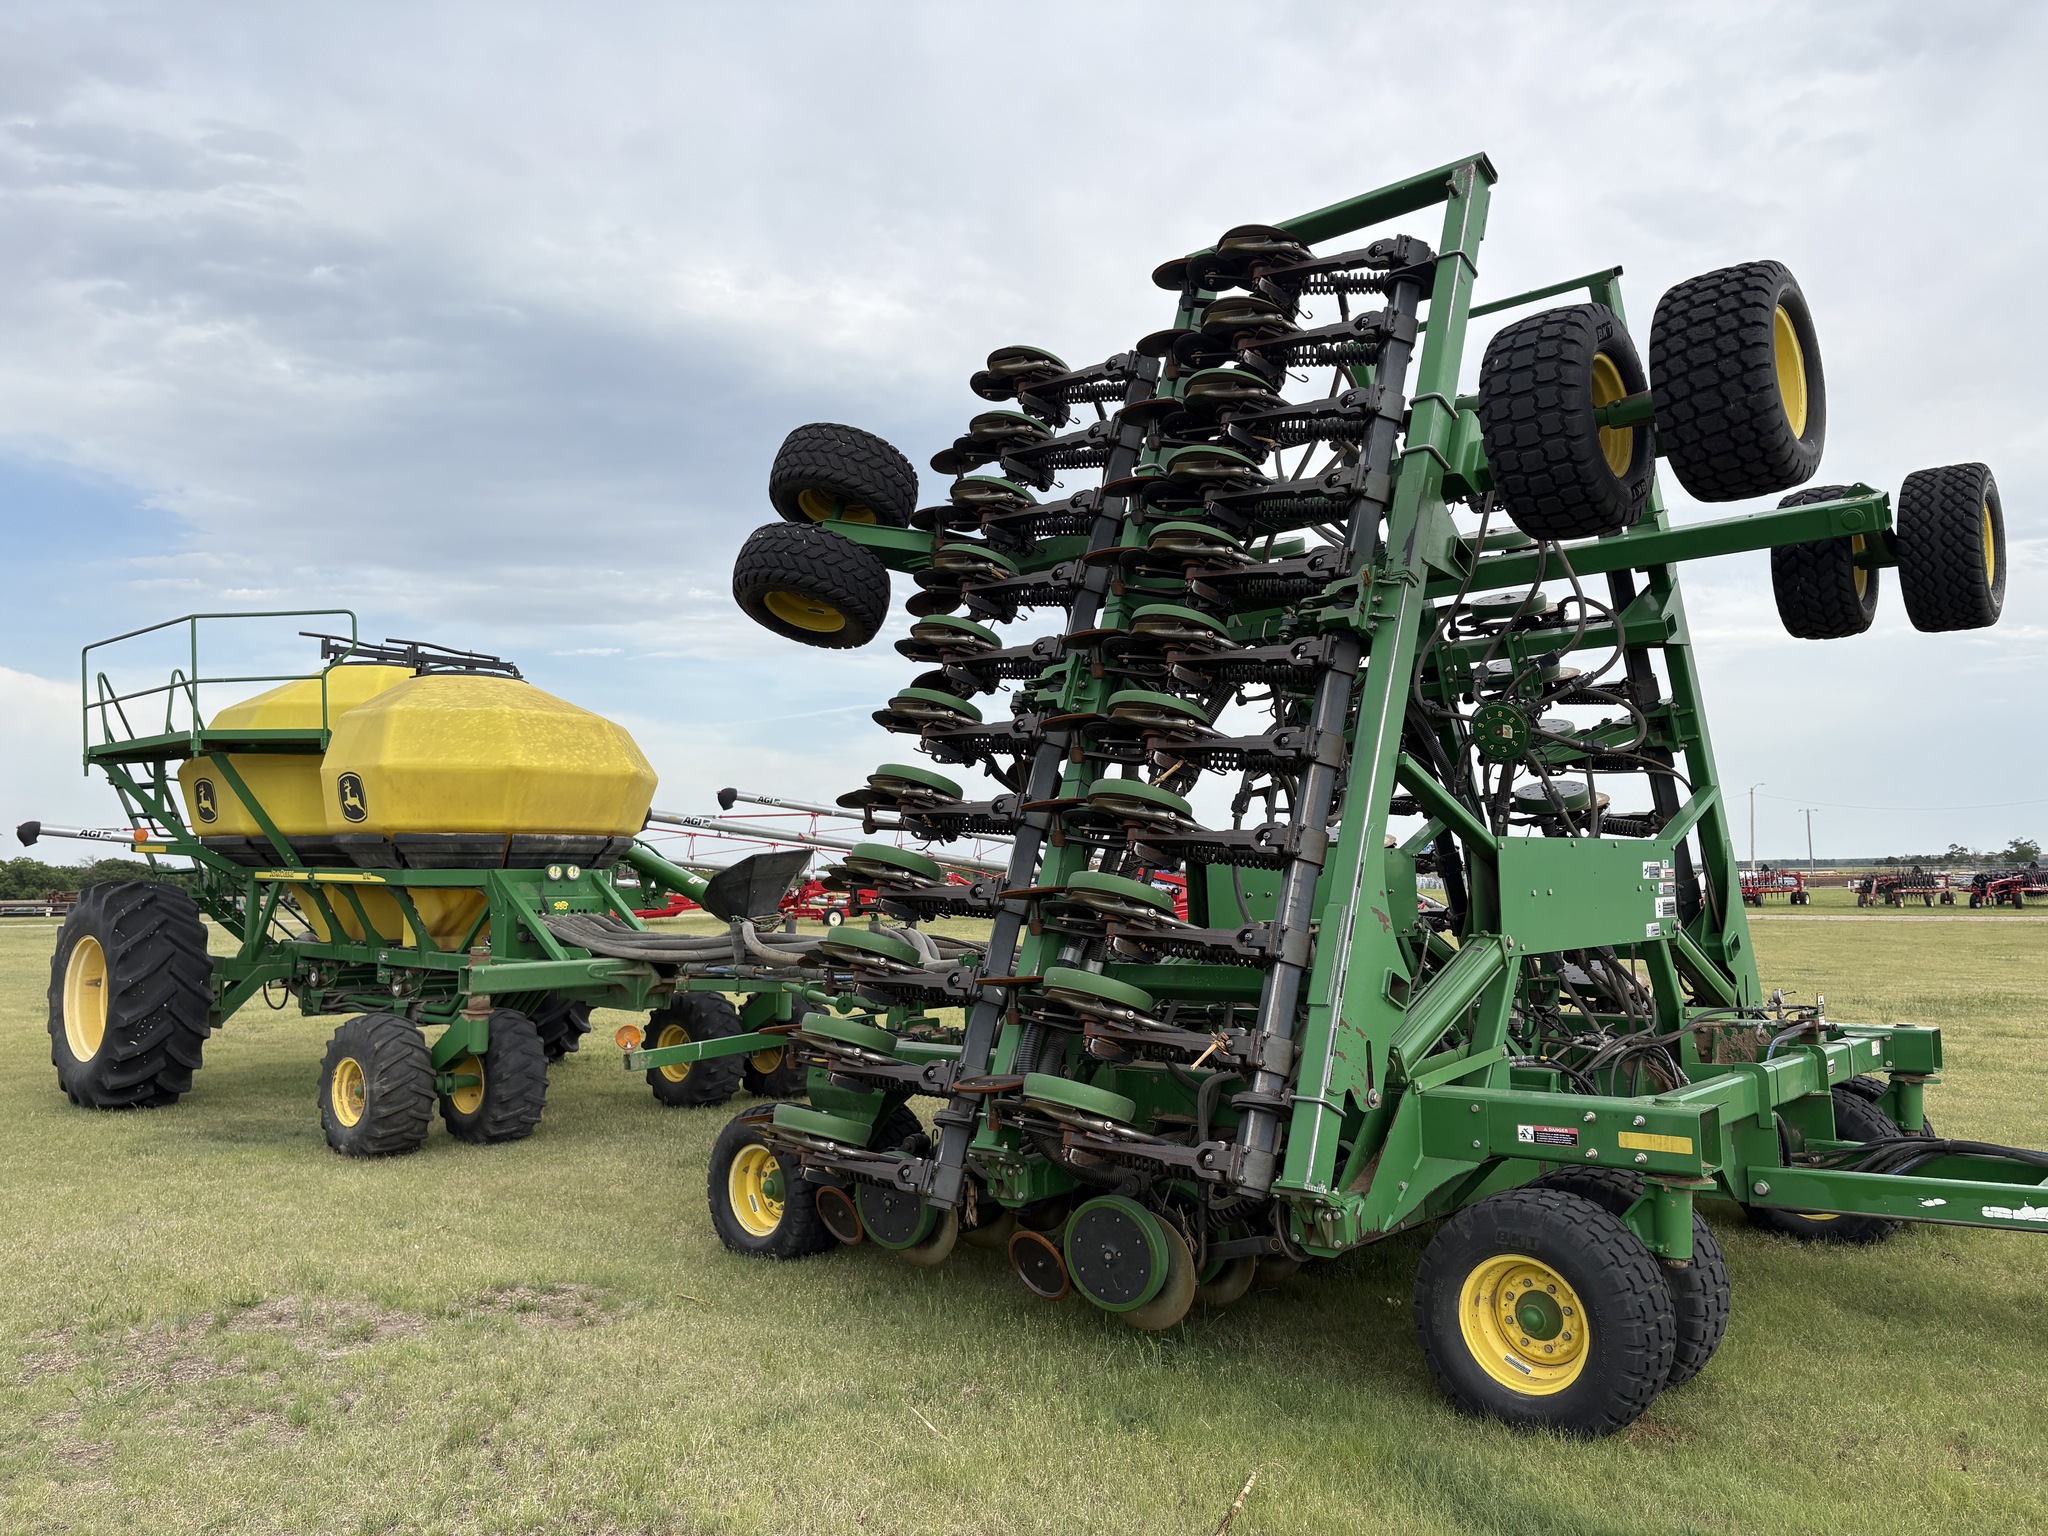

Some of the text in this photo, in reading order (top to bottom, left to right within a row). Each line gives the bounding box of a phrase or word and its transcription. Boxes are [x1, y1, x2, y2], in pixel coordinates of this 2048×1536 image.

[1596, 320, 1613, 343] BKT
[1631, 478, 1647, 499] BKT
[756, 795, 774, 805] AGI
[683, 816, 702, 826] AGI
[79, 829, 101, 838] AGI
[1496, 1229, 1541, 1250] BKT
